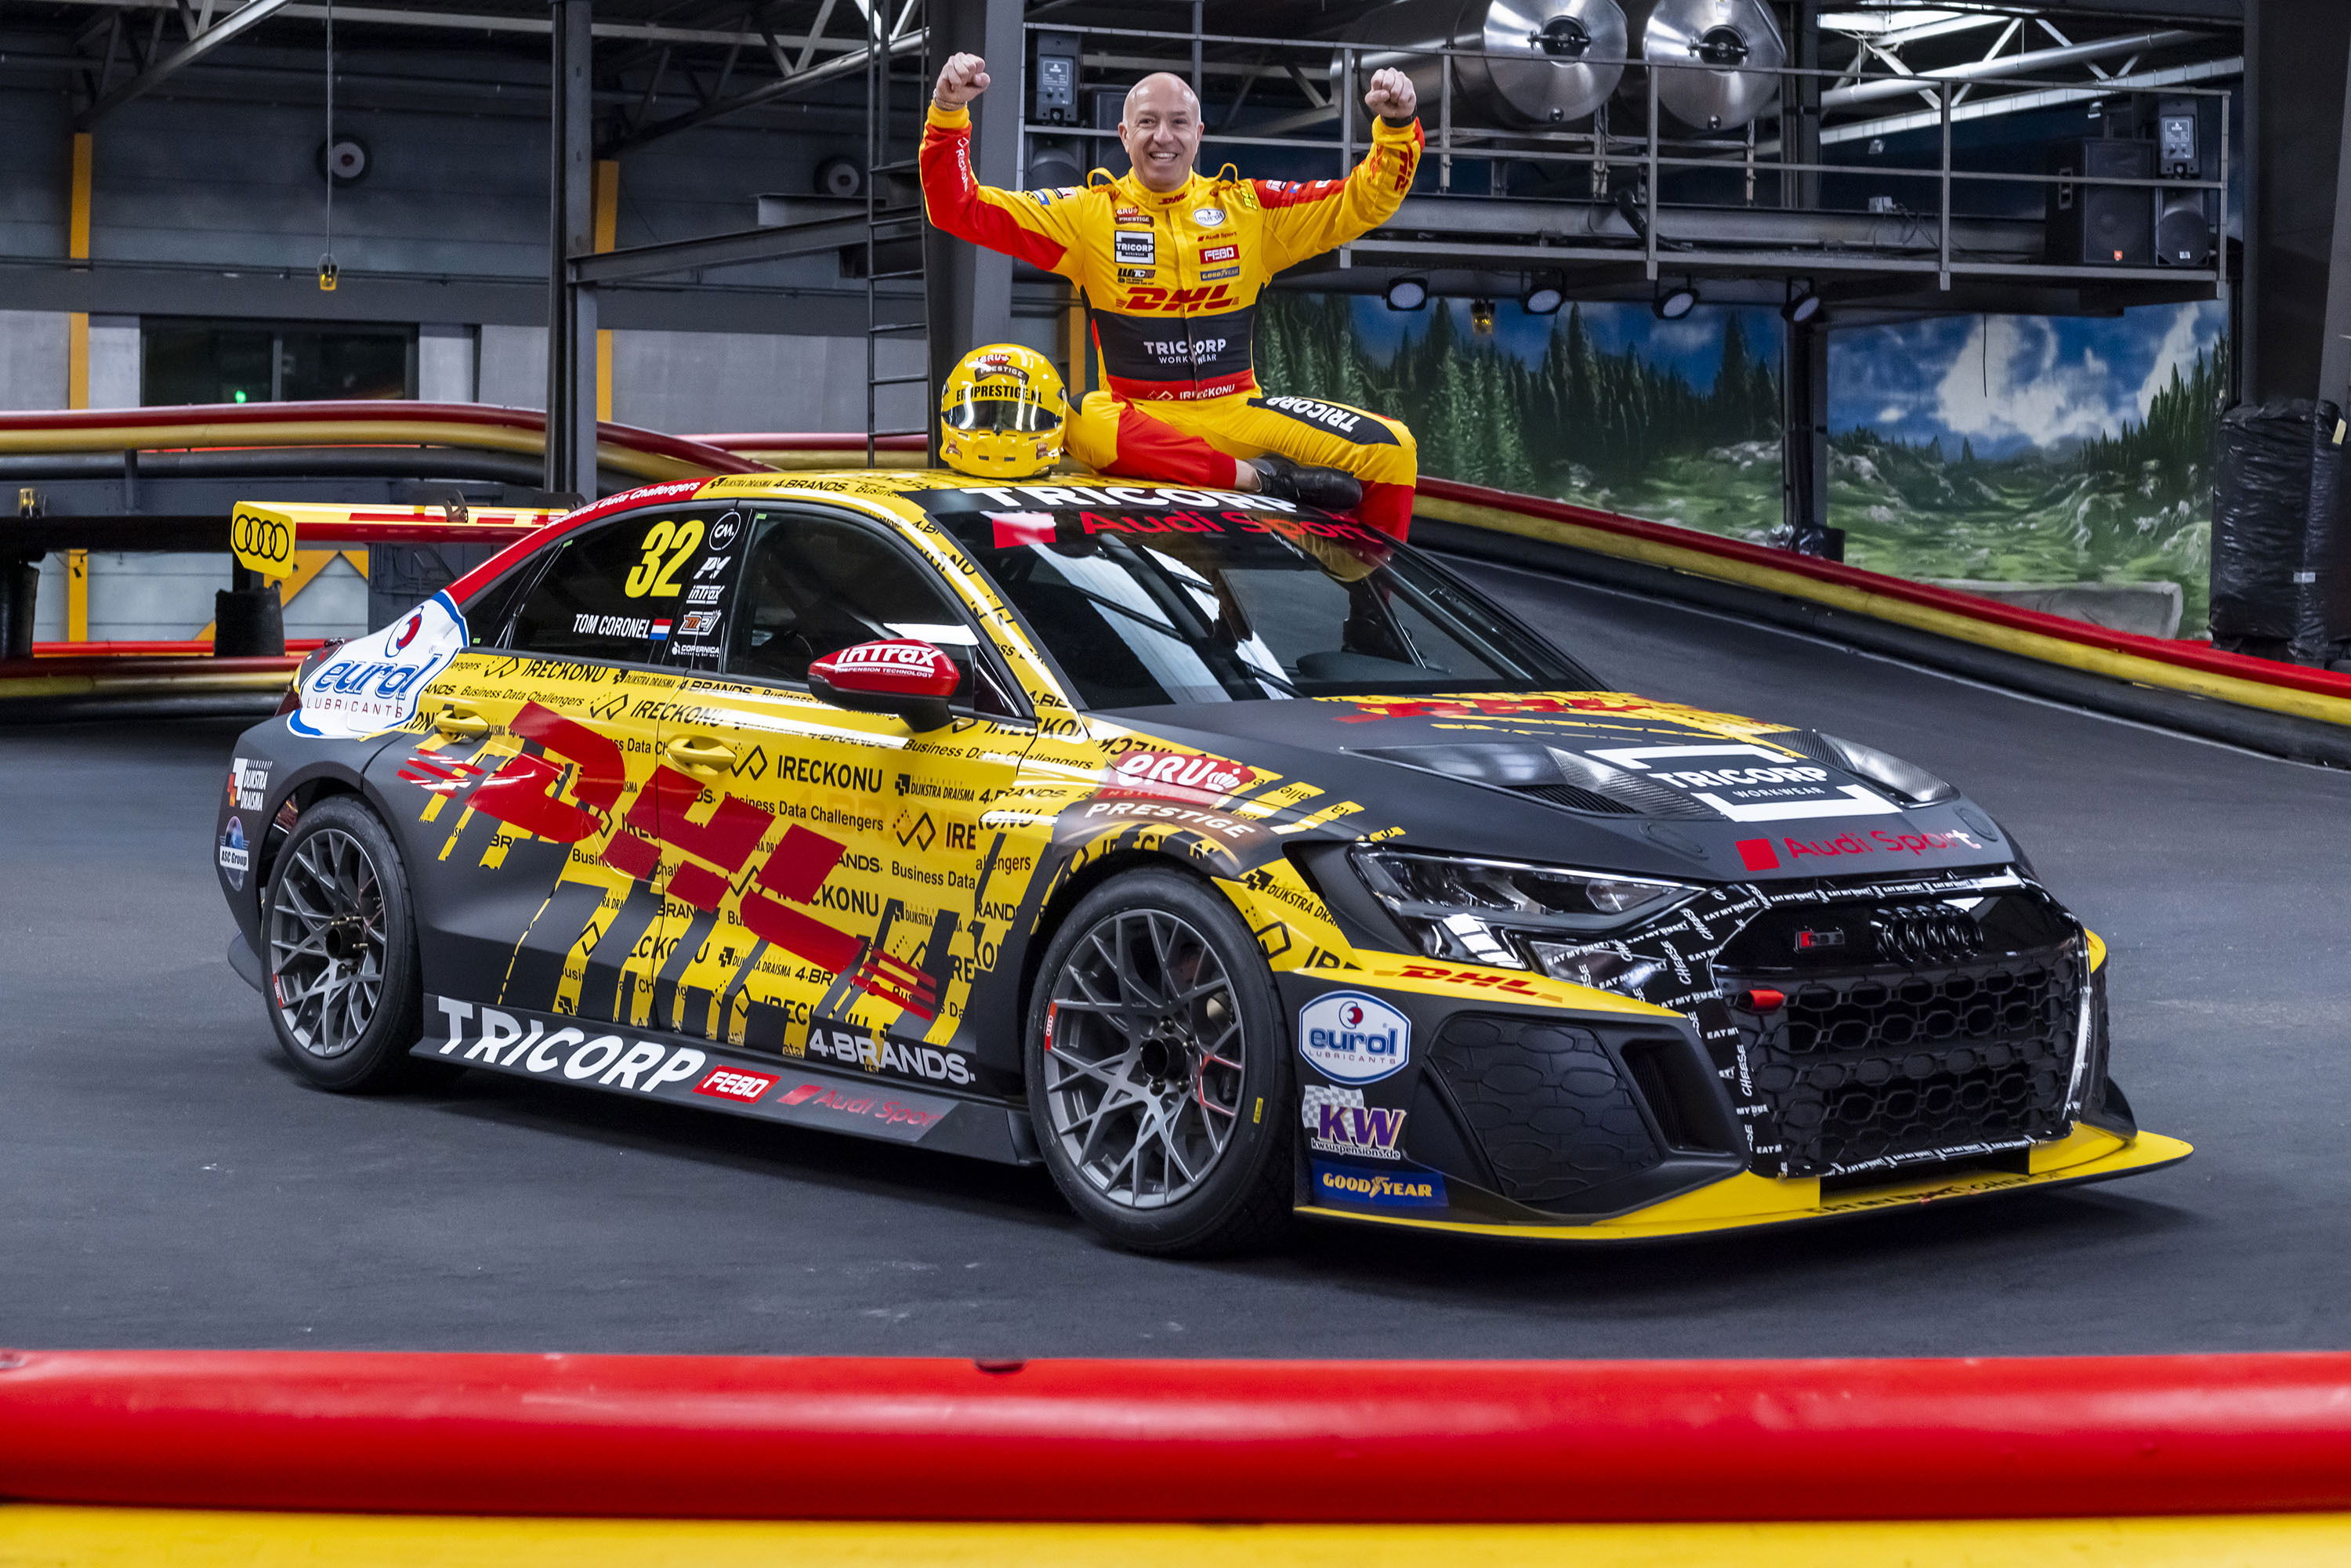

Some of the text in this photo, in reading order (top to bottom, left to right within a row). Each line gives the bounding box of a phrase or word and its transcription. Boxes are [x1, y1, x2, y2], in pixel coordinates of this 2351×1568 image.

[1116, 243, 1154, 252] TRICORP
[1204, 247, 1234, 262] FEBO
[1124, 284, 1235, 313] DHL
[1266, 396, 1360, 433] TRICORP
[629, 481, 701, 501] Challengers
[960, 487, 1298, 513] TRICORP
[1079, 510, 1384, 545] Audi Sport
[625, 519, 705, 598] 32
[573, 614, 650, 639] TOM CORONEL
[680, 644, 720, 654] COPERNICA
[313, 653, 444, 701] eurol
[520, 659, 607, 683] IRECKONU
[882, 668, 933, 679] TECHNOLOGY
[460, 684, 502, 698] Business
[502, 688, 525, 701] Data
[526, 691, 585, 707] Challengers
[306, 697, 403, 719] LUBRICANTS
[627, 738, 652, 754] Data
[902, 739, 963, 757] Business
[777, 755, 883, 794] IRECKONU
[1646, 766, 1830, 790] TRICORP
[942, 786, 976, 802] DRAISMA
[1732, 786, 1827, 799] WORKWEAR
[779, 801, 806, 819] Data
[810, 806, 884, 831] Challengers
[1084, 802, 1255, 839] PRESTIGE
[462, 700, 865, 976] DHL
[1782, 829, 1983, 858] Audi Sport
[220, 849, 248, 867] ASC Group
[891, 860, 944, 886] Business
[947, 871, 976, 890] Data
[1266, 884, 1314, 914] DIJKSTRA
[1703, 911, 1721, 922] EAT
[1627, 934, 1645, 944] EAT
[1645, 929, 1660, 939] MY
[1547, 953, 1566, 966] EAT
[1567, 947, 1581, 959] MY
[1660, 940, 1693, 985] CHEESE
[1687, 951, 1707, 962] EAT
[761, 962, 792, 978] DRAISMA
[1394, 965, 1539, 997] DHL
[1675, 994, 1692, 1005] MY
[438, 995, 706, 1093] TRICORP
[1309, 1027, 1398, 1057] eurol
[1707, 1029, 1726, 1040] EAT
[809, 1028, 976, 1085] 4.BRANDS.
[1308, 1050, 1396, 1065] LUBRICANTS
[1737, 1044, 1753, 1097] CHEESE
[702, 1070, 770, 1098] FEBO
[813, 1090, 872, 1114] Audi
[1736, 1106, 1750, 1116] MY
[1317, 1103, 1407, 1150] KW
[1311, 1138, 1401, 1161] kwsuspensions.de
[1756, 1145, 1774, 1154] EAT
[1322, 1172, 1433, 1198] GOODYEAR
